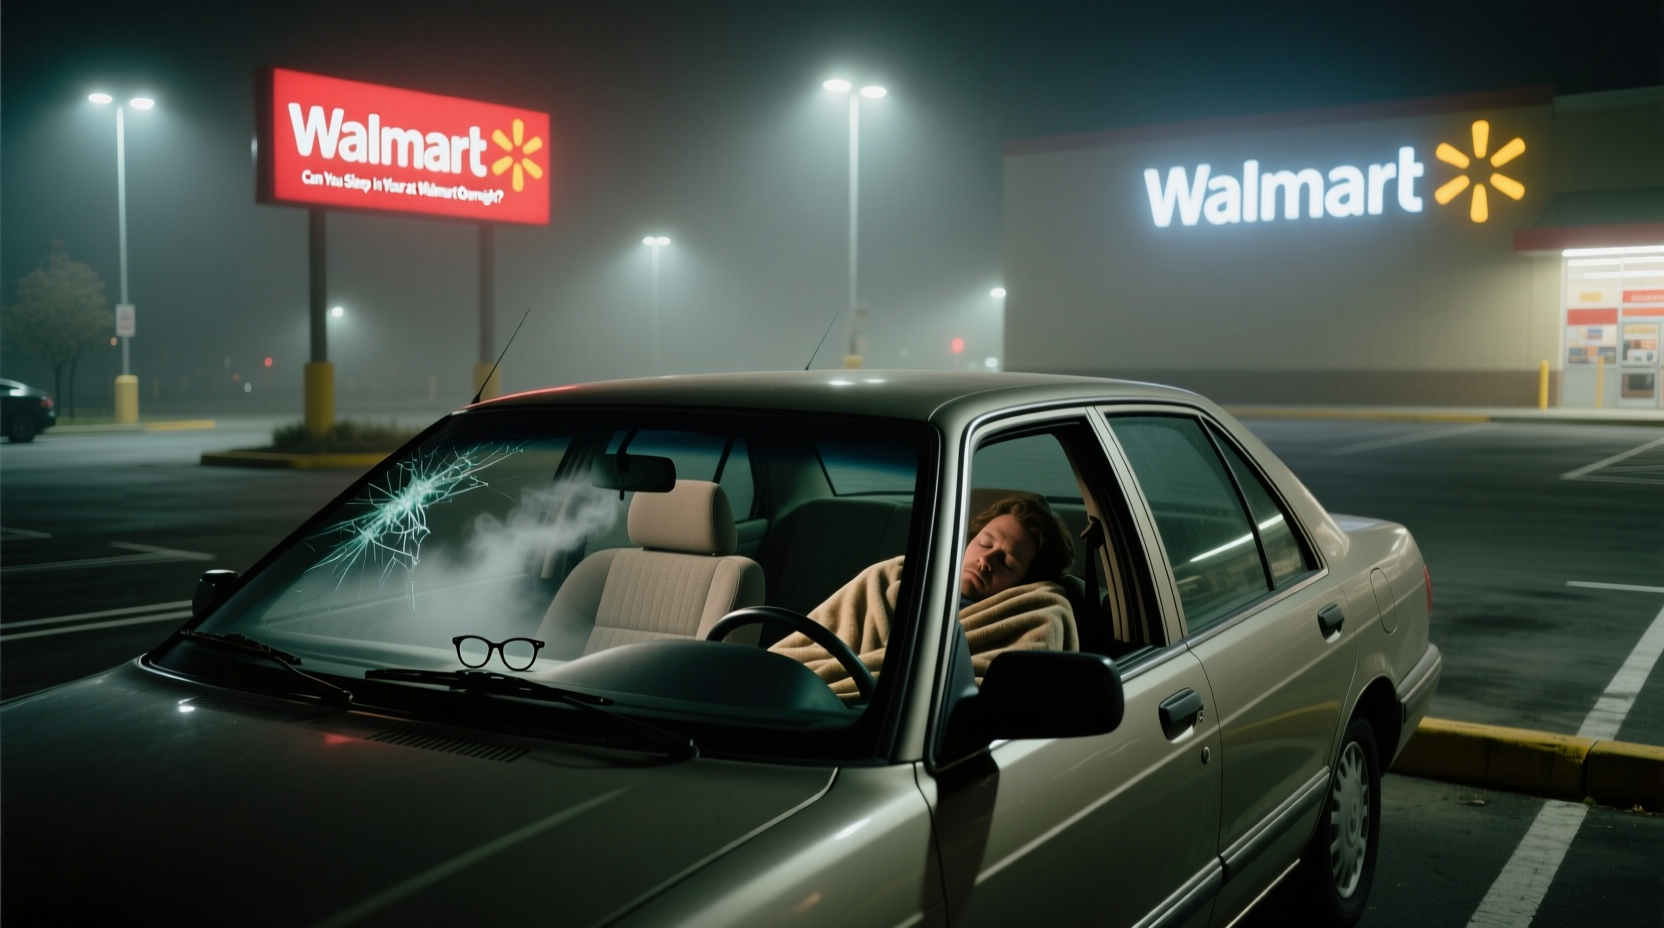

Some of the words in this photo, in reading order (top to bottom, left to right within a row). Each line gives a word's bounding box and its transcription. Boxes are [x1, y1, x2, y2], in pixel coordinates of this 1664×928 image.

[288, 102, 487, 177] Walmart
[302, 169, 324, 185] Can
[1143, 146, 1424, 228] Walmart
